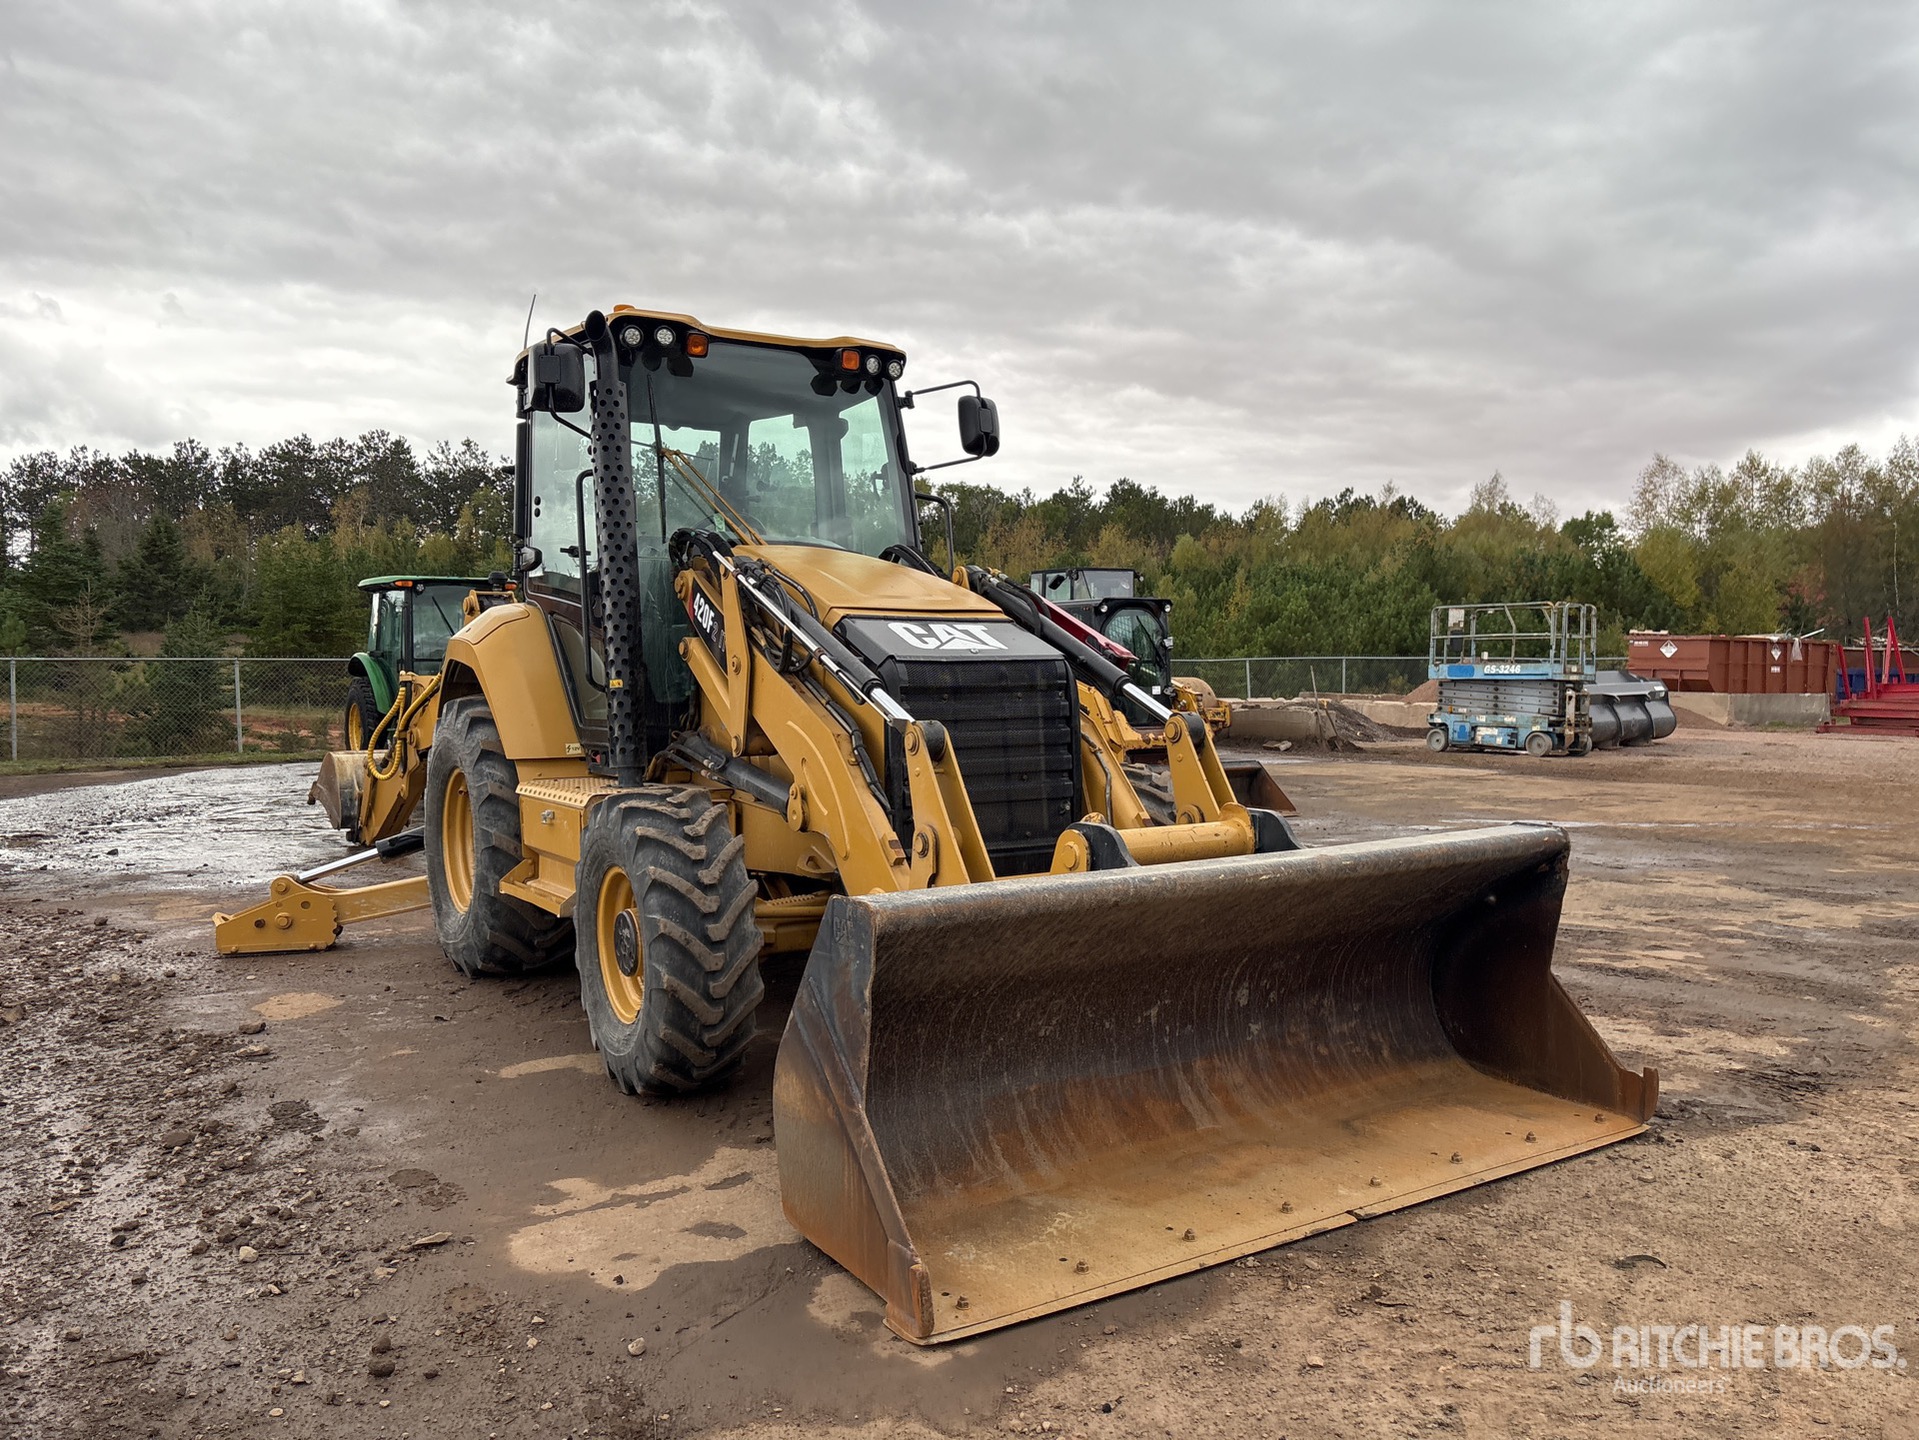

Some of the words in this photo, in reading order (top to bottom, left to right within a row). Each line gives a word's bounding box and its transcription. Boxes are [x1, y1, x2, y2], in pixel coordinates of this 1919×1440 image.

[887, 622, 1009, 649] CAT
[1484, 665, 1521, 674] GS-3246
[833, 917, 854, 945] CAT
